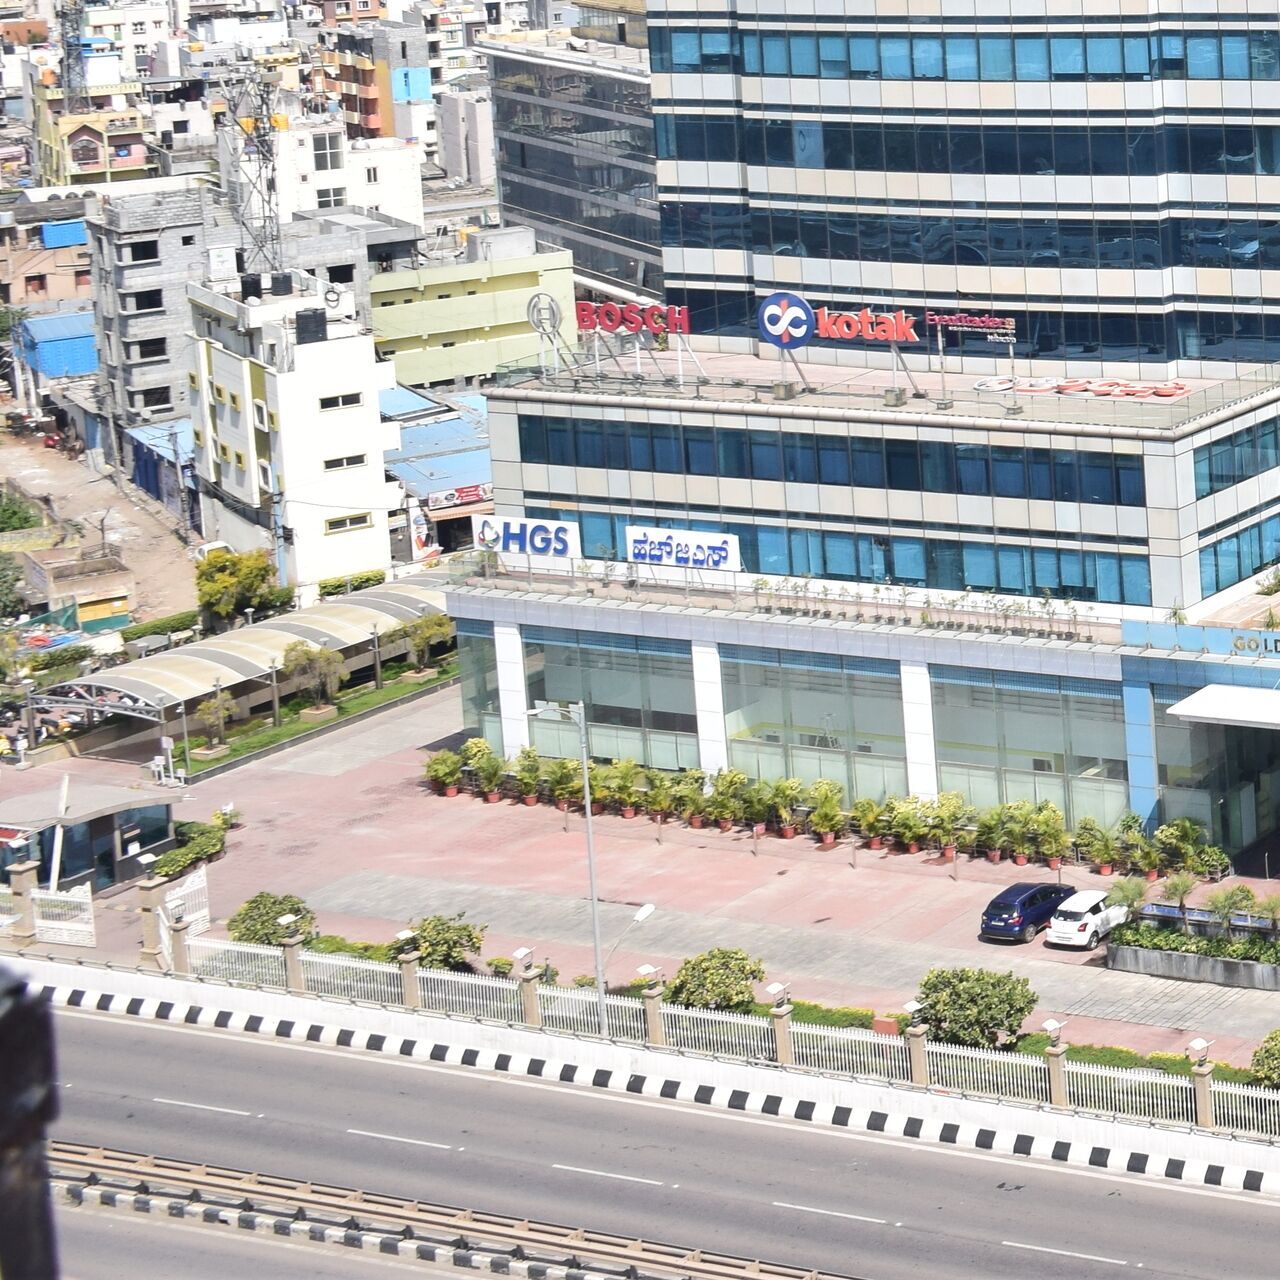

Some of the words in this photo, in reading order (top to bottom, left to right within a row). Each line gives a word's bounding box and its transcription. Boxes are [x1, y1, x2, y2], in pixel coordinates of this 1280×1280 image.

[576, 301, 689, 334] BOSCH
[817, 306, 920, 342] kotak
[502, 521, 569, 555] HGS
